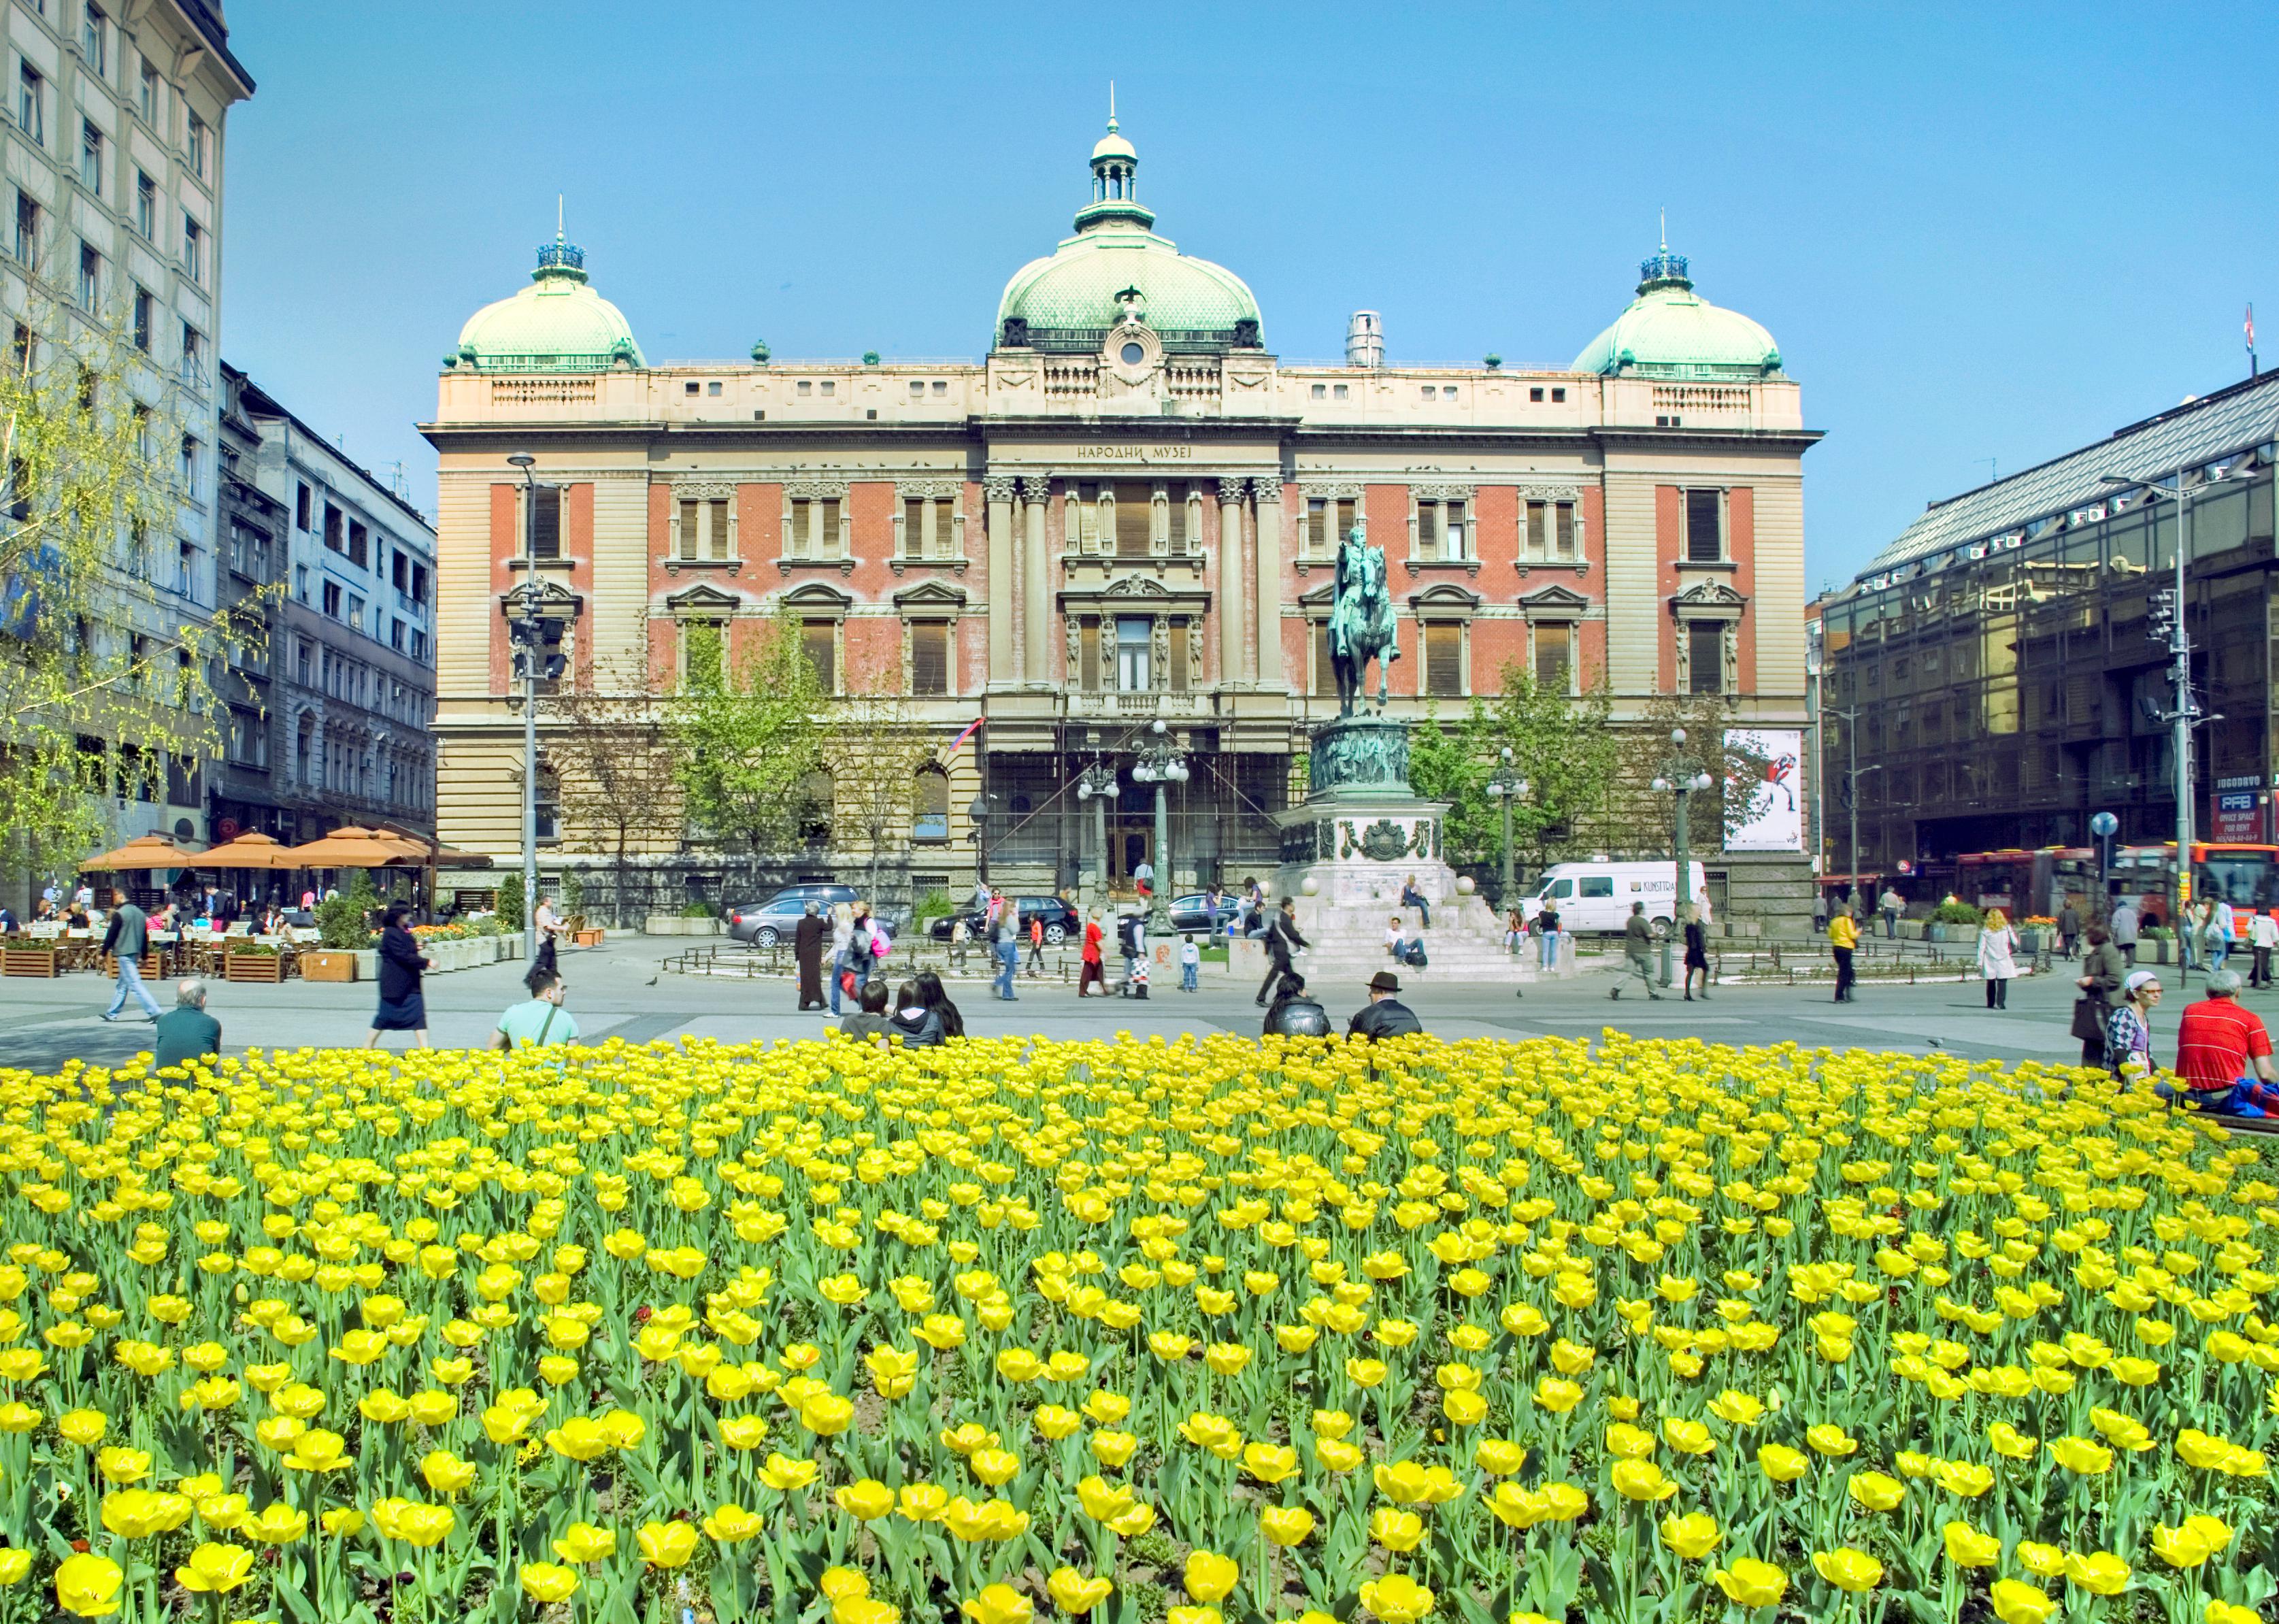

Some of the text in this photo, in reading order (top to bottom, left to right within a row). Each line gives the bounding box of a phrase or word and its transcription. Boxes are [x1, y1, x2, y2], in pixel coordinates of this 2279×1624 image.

[1078, 446, 1191, 458] НАРОДНИ МУЗЕЈ
[2218, 775, 2260, 789] JUGODRVO
[2222, 795, 2251, 810] PFB
[2219, 812, 2255, 822] OFFICE SPACE
[2224, 823, 2250, 833] FOR RENT
[1644, 881, 1676, 892] KUNSTTRA
